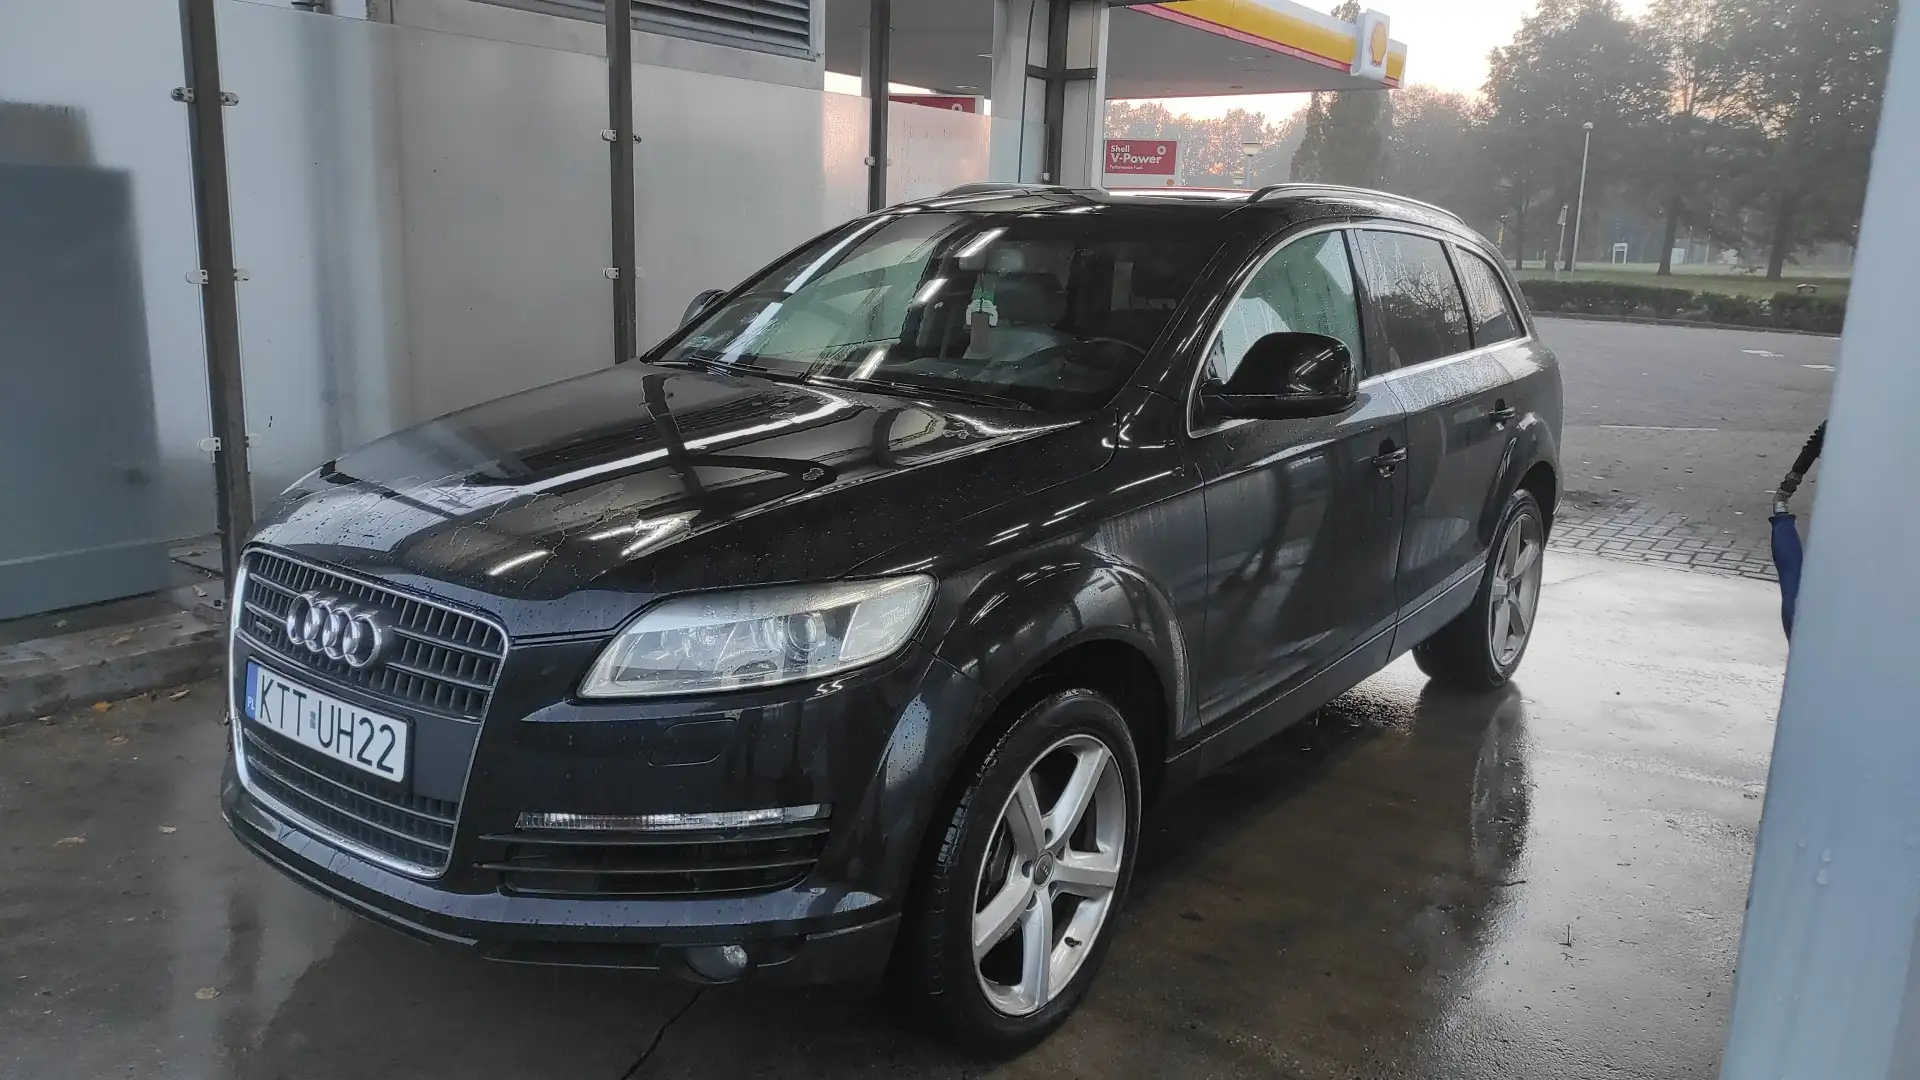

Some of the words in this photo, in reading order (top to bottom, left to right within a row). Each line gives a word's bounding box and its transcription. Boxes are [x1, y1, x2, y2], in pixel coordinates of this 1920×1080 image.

[1110, 144, 1130, 152] Shell
[1110, 152, 1162, 164] V-Power
[260, 674, 308, 737] KTT
[317, 699, 396, 775] UH22
